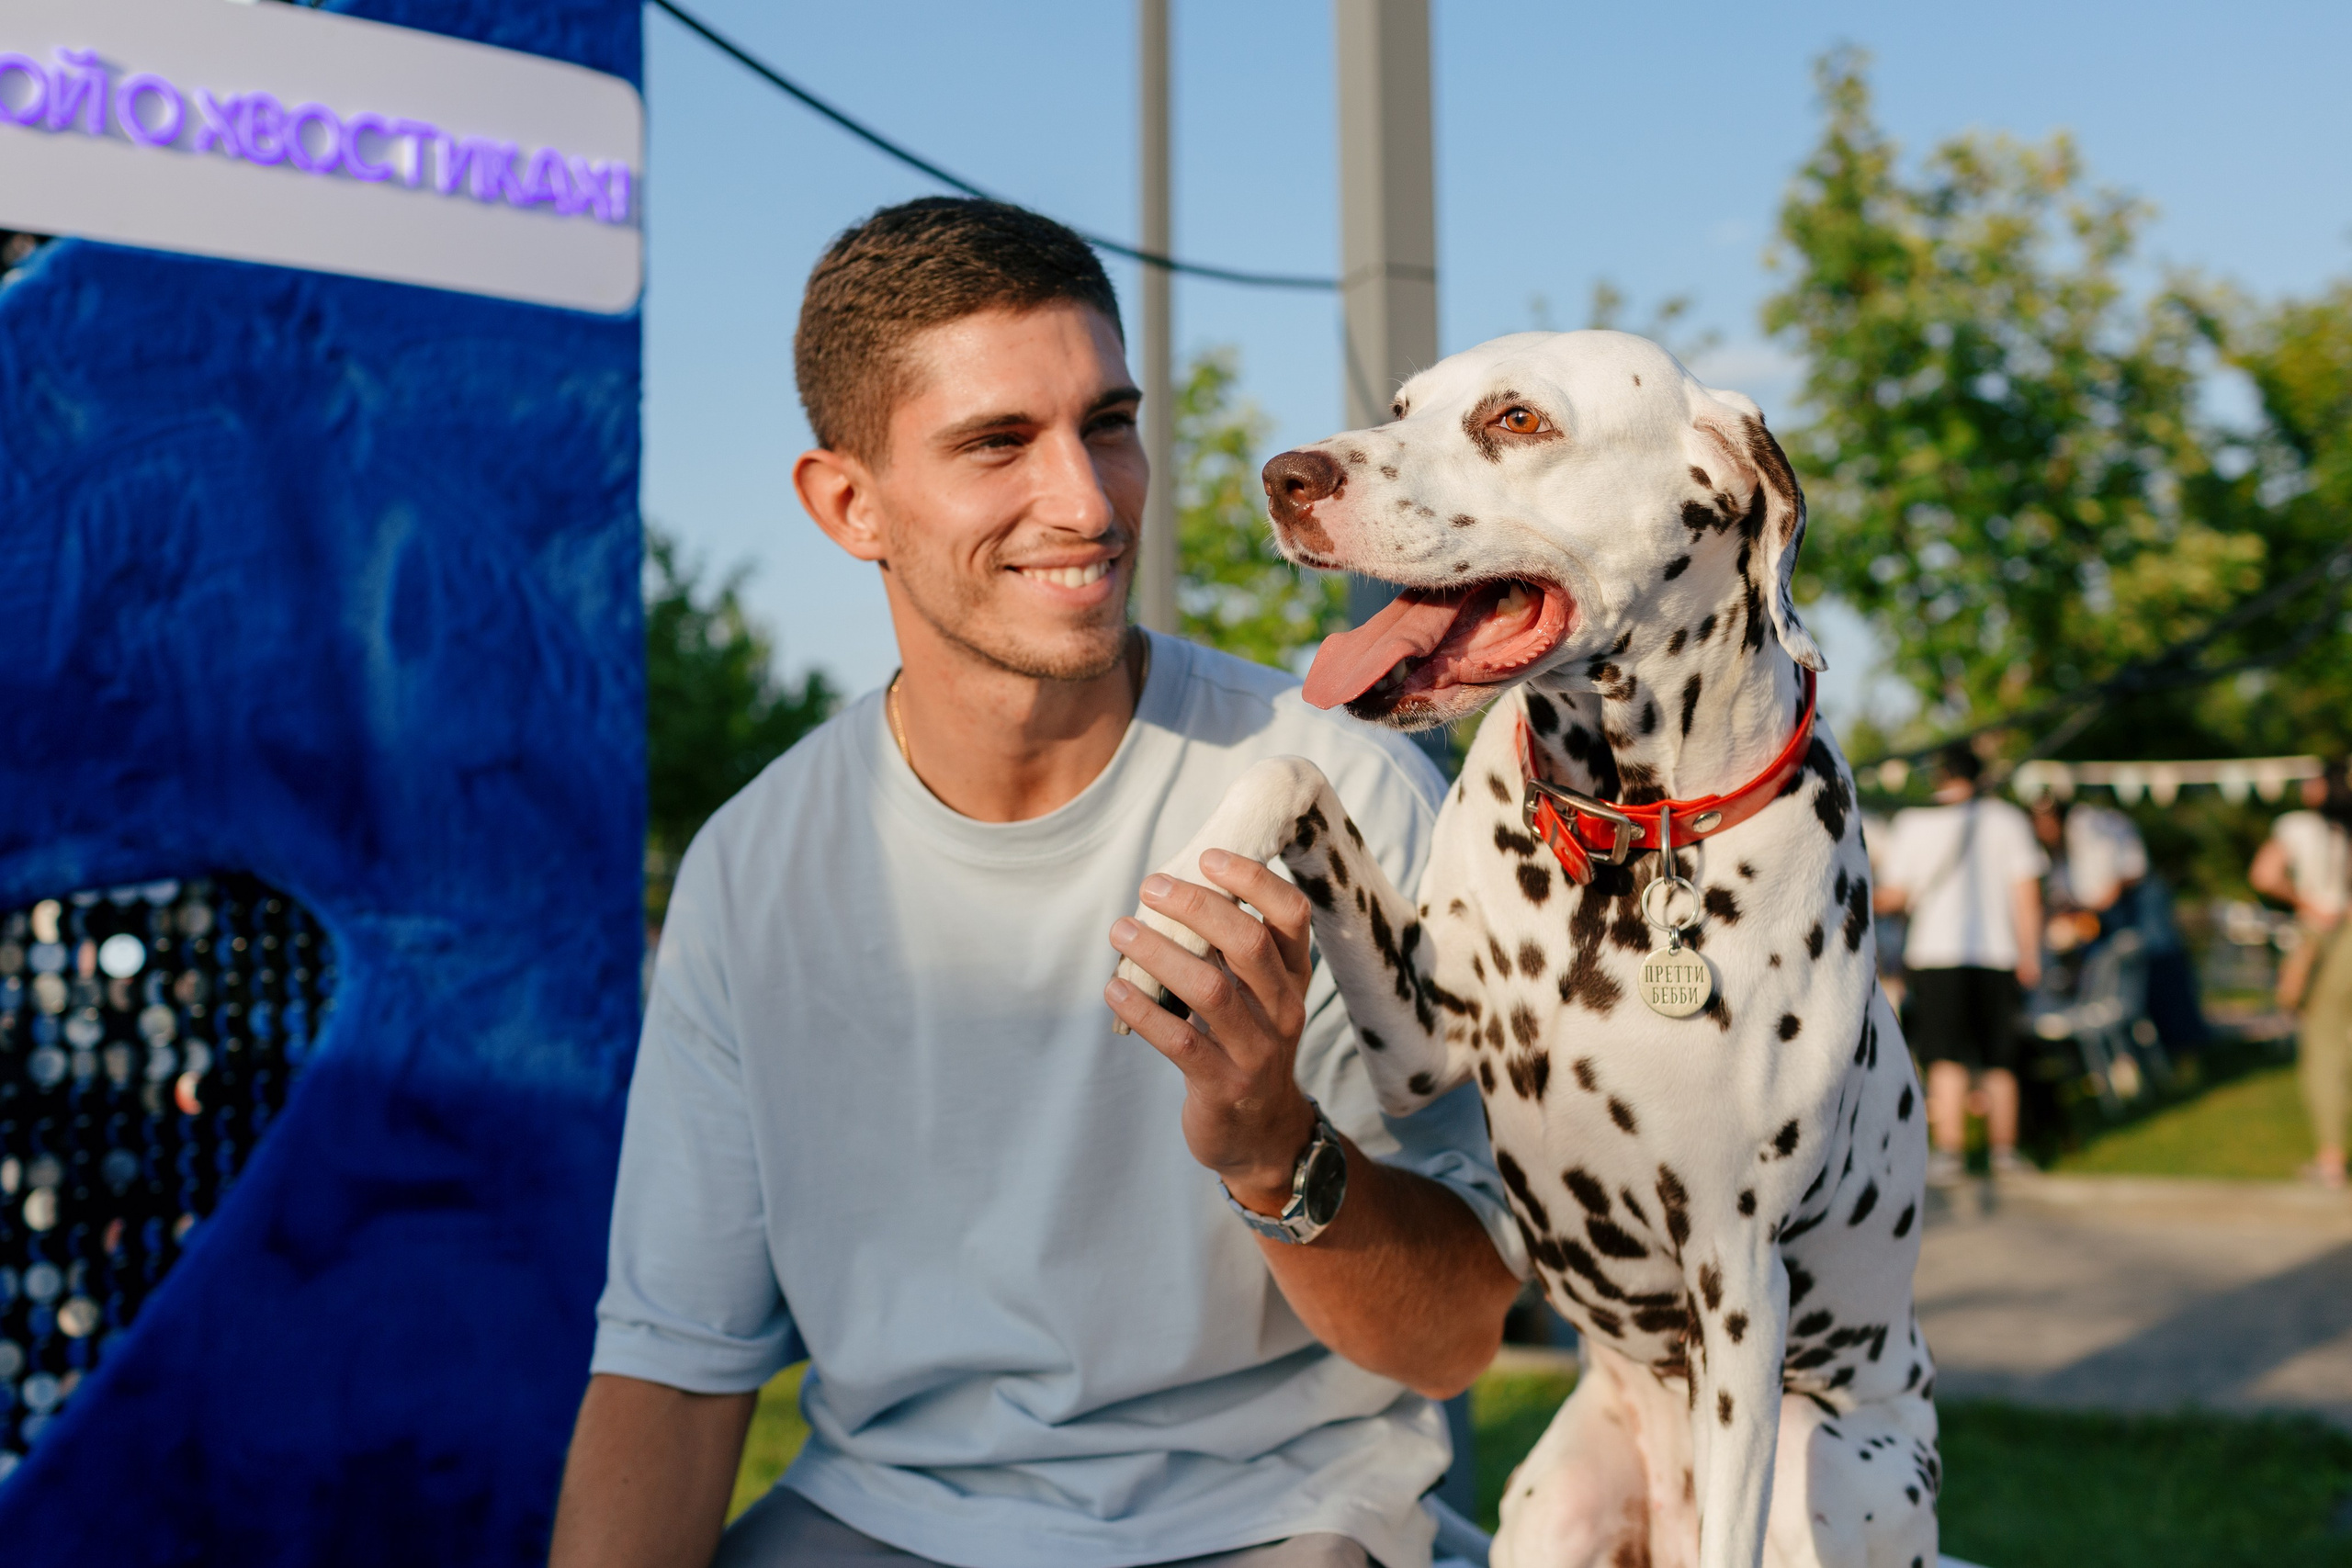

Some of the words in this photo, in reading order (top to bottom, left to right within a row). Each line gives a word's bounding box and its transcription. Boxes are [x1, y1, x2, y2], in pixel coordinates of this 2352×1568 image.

[114, 73, 187, 147] О
[1645, 965, 1704, 983] ПРЕТТИ
[1652, 987, 1698, 1004] БЕББИ
